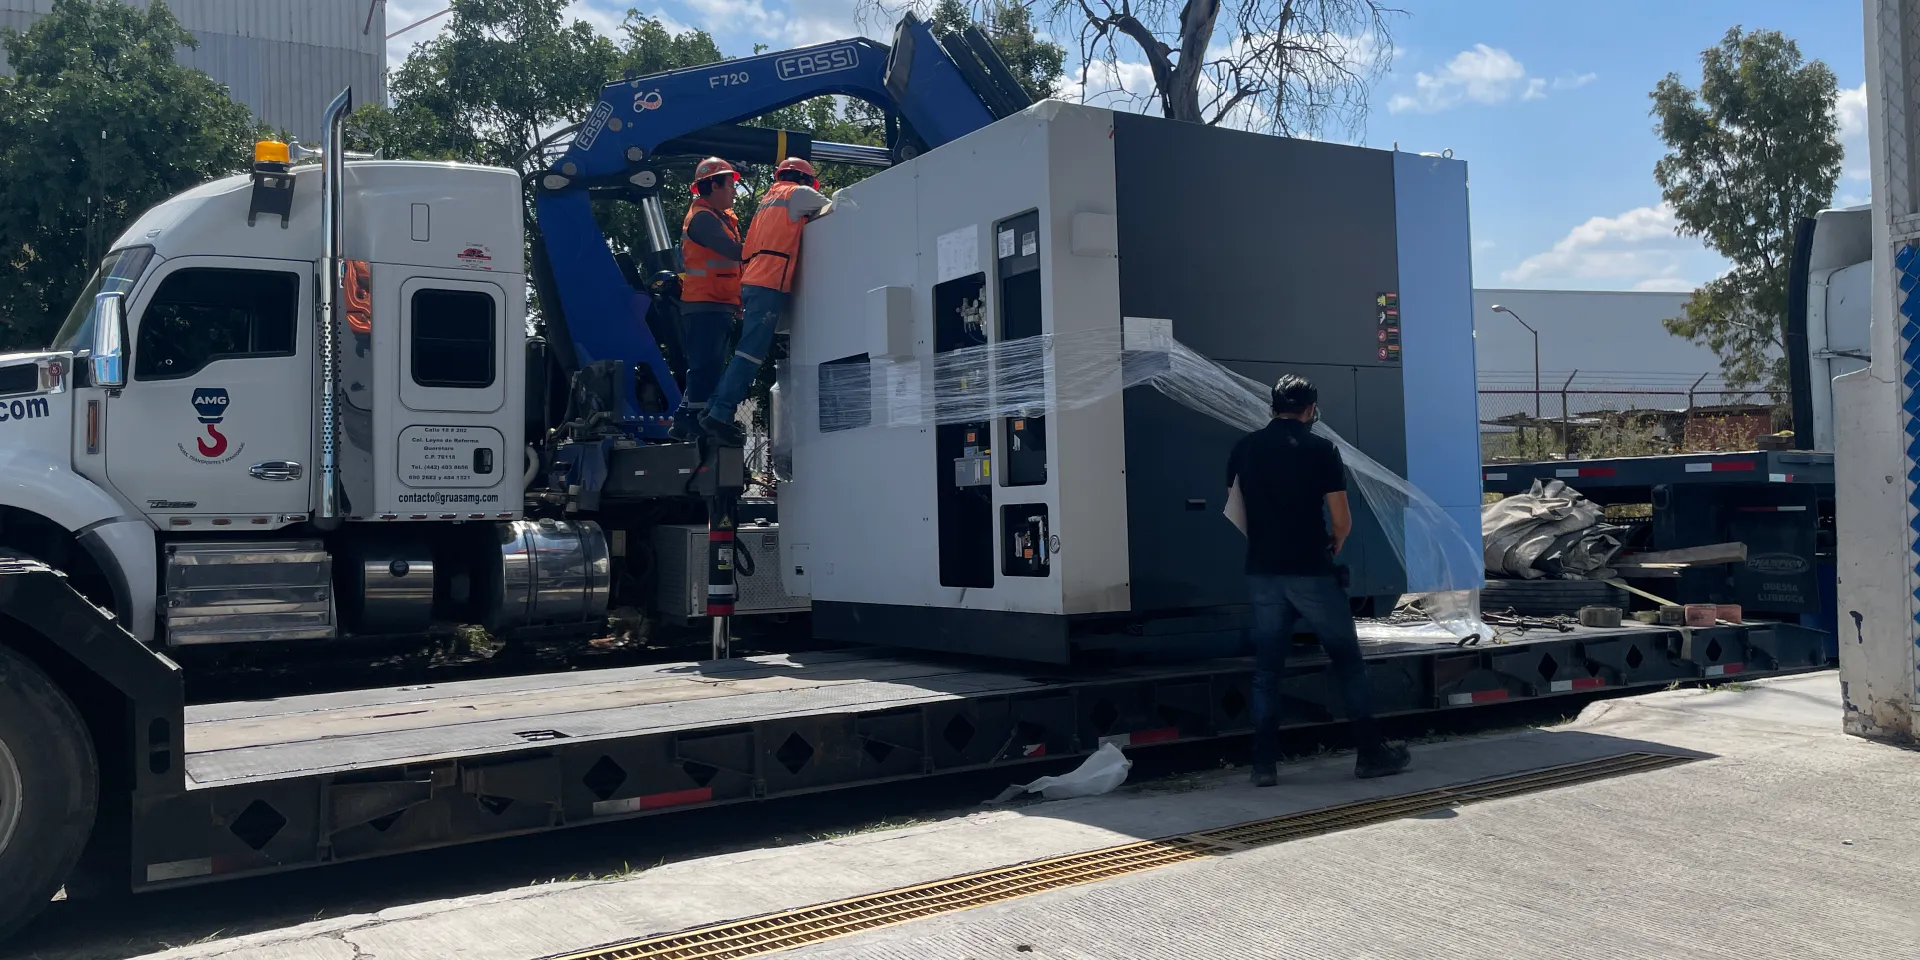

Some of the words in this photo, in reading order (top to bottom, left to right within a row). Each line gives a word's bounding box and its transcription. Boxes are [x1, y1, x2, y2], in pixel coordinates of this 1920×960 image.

[781, 49, 854, 77] FASSI
[708, 71, 750, 89] F720
[579, 105, 611, 147] FASSI
[194, 396, 227, 405] AMG
[398, 491, 499, 505] contacto@gruasamg.com
[1757, 593, 1805, 604] LUBBOCK
